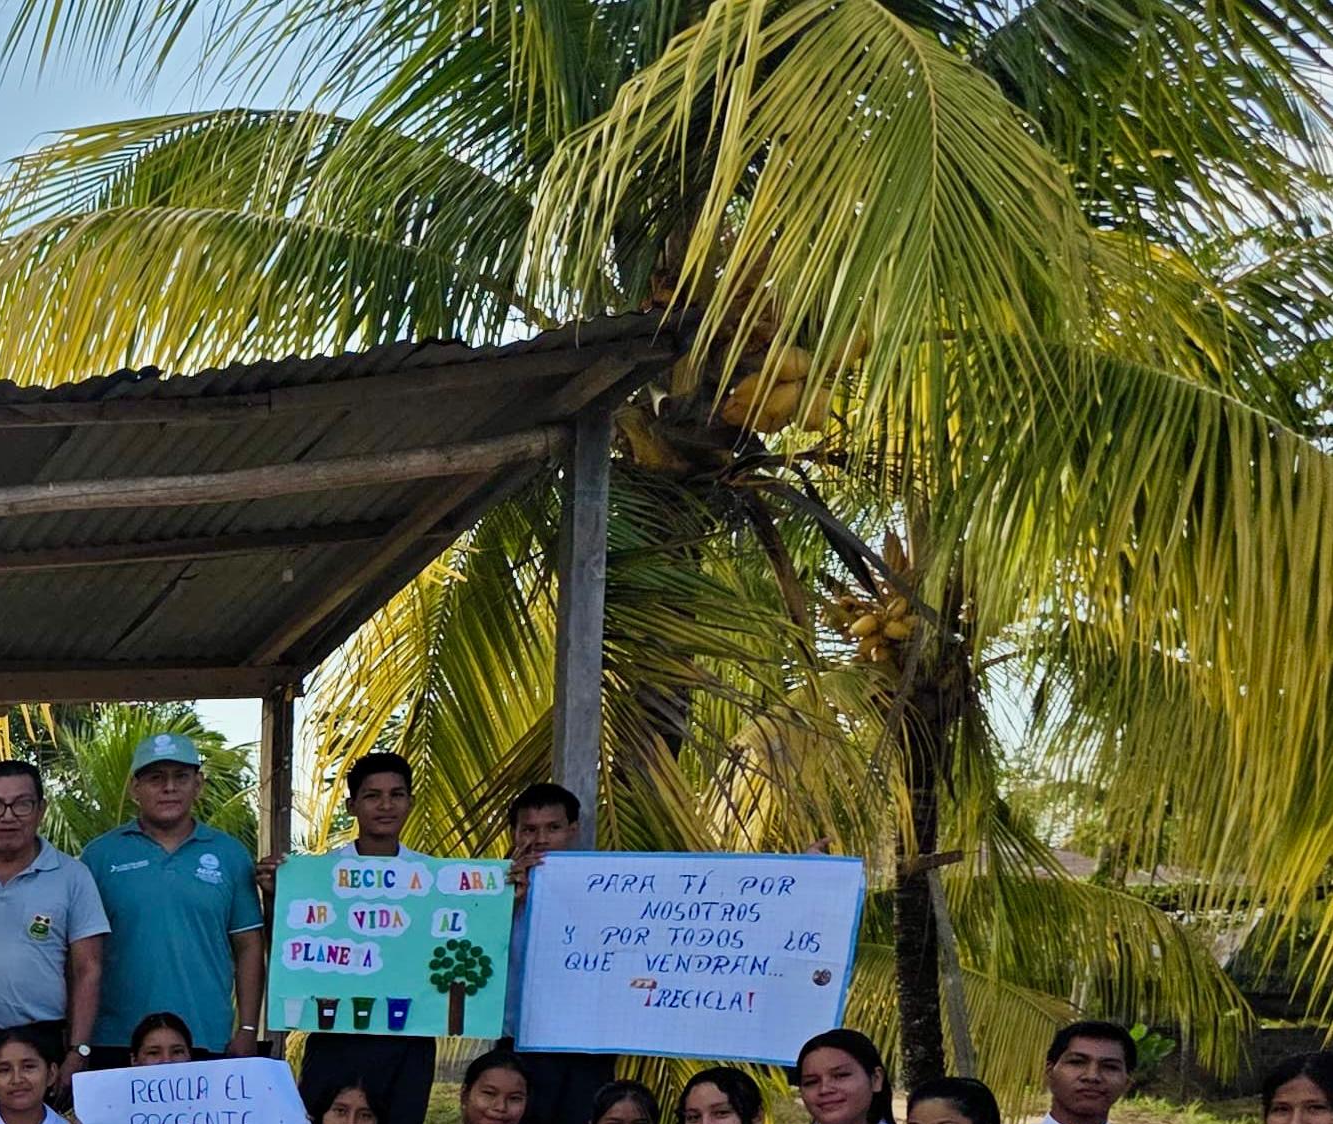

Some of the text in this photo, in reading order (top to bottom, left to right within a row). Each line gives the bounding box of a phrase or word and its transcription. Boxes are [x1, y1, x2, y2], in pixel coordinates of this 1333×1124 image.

[338, 868, 497, 891] RECICA ARA
[587, 874, 655, 893] PARA
[738, 875, 796, 897] POR
[306, 906, 462, 933] AR VIDA AL
[640, 901, 761, 922] NOSOTROS
[601, 927, 650, 946] POR
[669, 927, 744, 949] TODOS
[783, 931, 821, 953] LOS
[291, 942, 372, 968] PLANEA
[565, 952, 615, 972] QUE
[131, 1074, 253, 1104] RECICLA EL
